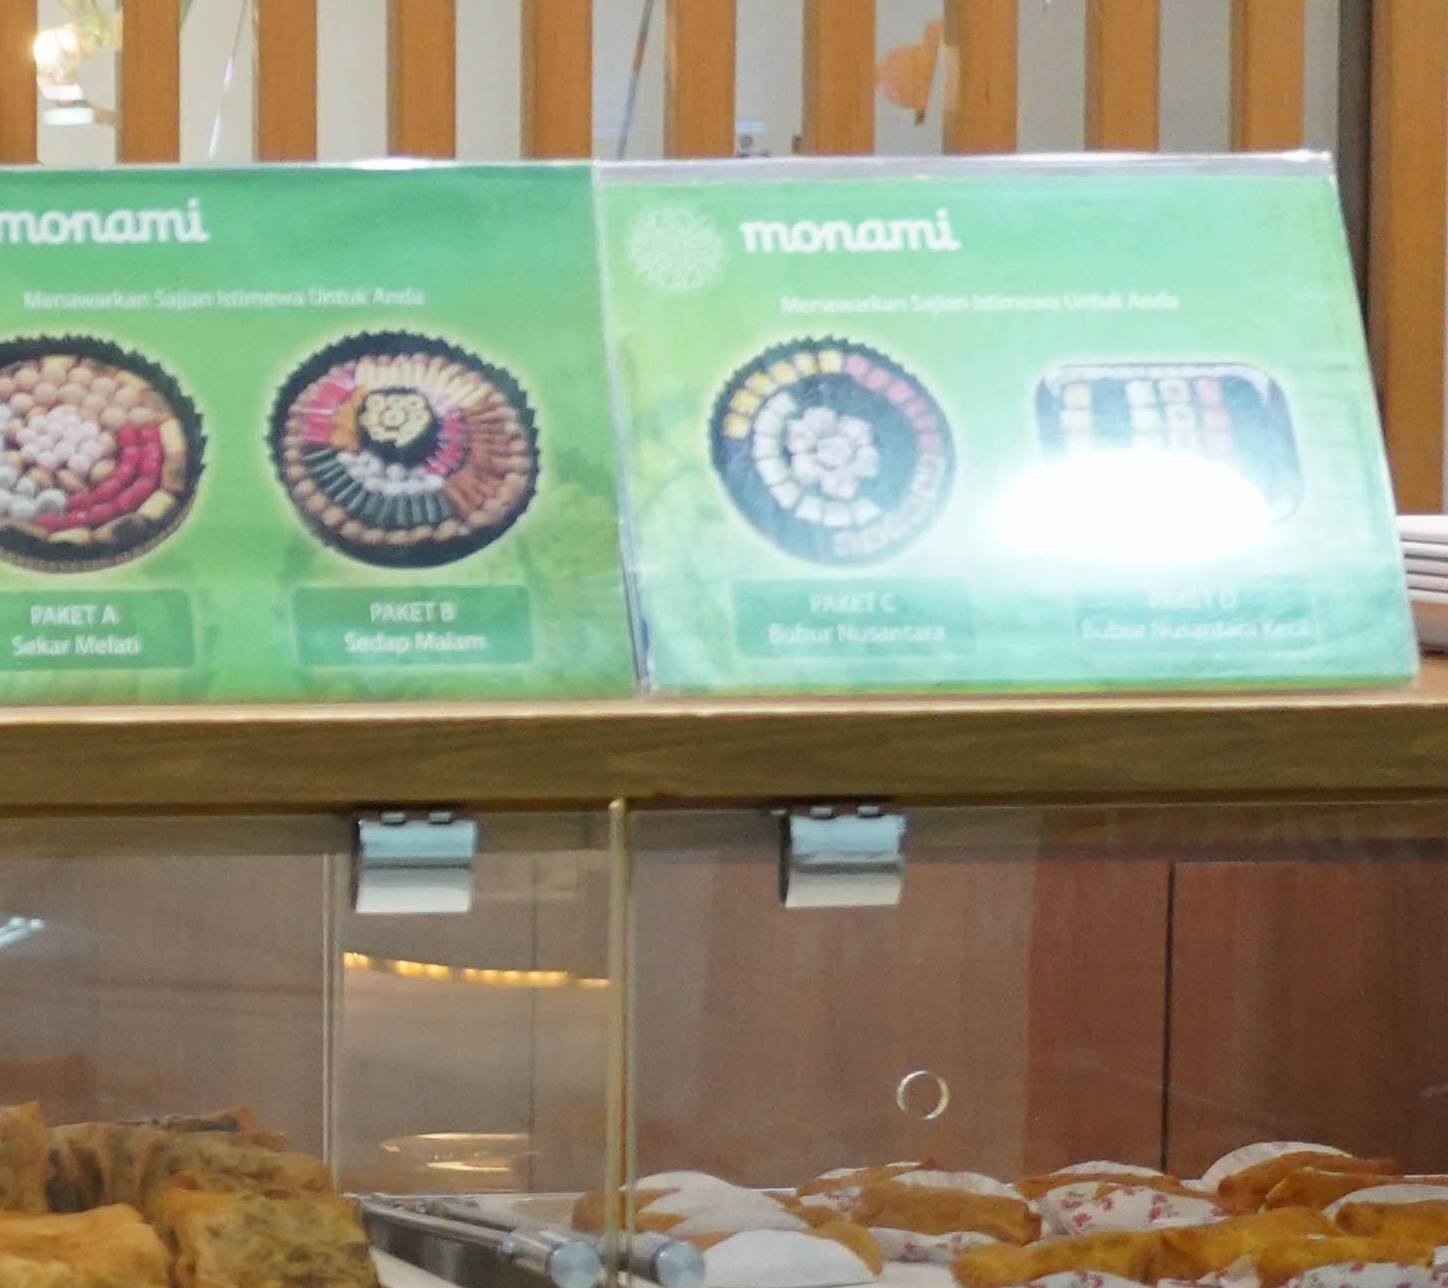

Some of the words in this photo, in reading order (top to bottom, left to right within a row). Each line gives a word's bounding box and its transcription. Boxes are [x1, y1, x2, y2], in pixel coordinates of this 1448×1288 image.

[739, 208, 962, 253] monami
[310, 287, 368, 306] Untuk
[373, 287, 425, 306] Anda
[370, 602, 436, 623] PAKET
[439, 602, 457, 623] B
[810, 593, 876, 613] PAKET
[879, 593, 897, 613] C
[30, 604, 98, 625] PAKET
[101, 603, 120, 625] A
[343, 632, 410, 655] Sedap
[414, 632, 489, 651] Malam
[768, 623, 834, 644] Bubur
[837, 623, 946, 642] Nusantara
[12, 635, 71, 656] Sekar
[75, 635, 142, 655] Melati
